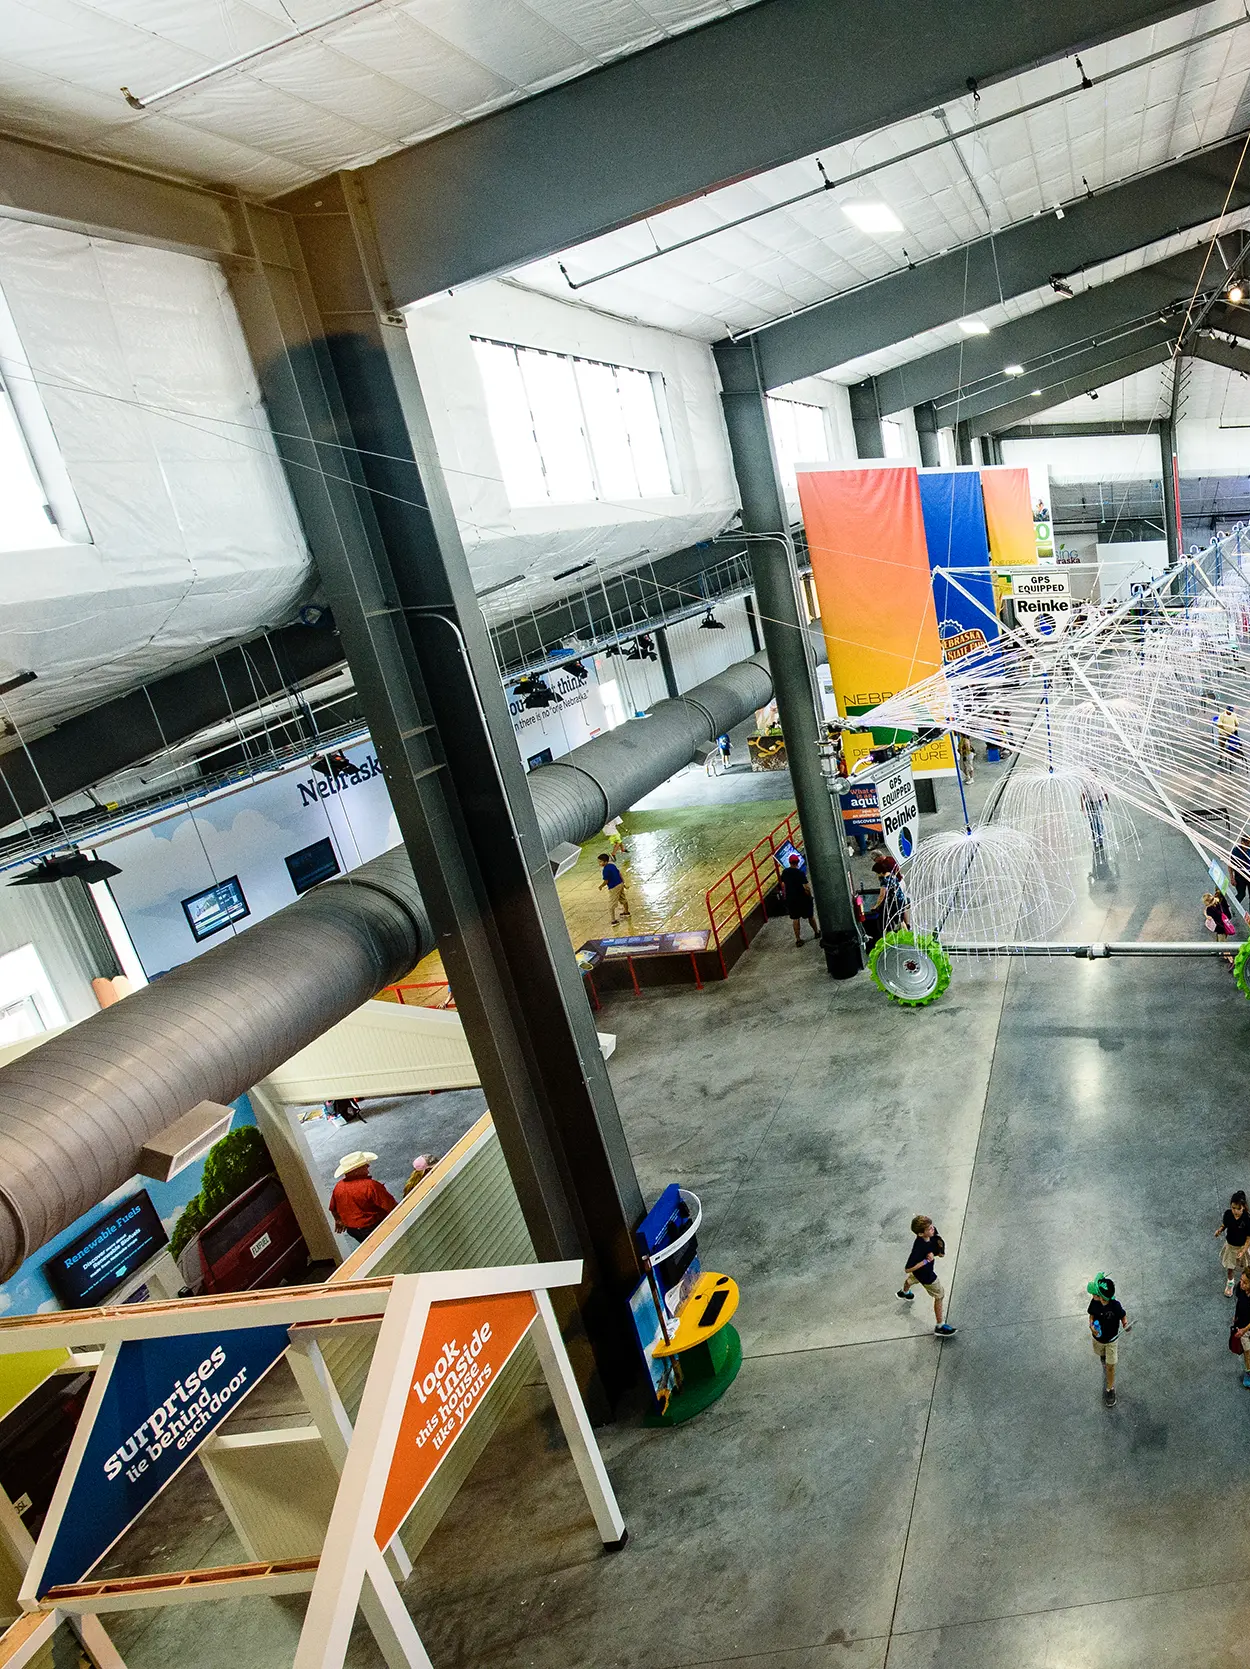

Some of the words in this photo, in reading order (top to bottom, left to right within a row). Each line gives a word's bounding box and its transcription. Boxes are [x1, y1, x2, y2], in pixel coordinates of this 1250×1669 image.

[1018, 584, 1065, 594] EQUIPPED
[1031, 576, 1050, 584] GPS
[1018, 600, 1069, 613] Reinke
[942, 631, 981, 649] EBRASKA
[948, 644, 968, 661] STATE
[296, 755, 384, 807] Nebrask
[882, 782, 912, 807] EQUIPPED
[889, 775, 902, 790] GPS
[884, 804, 916, 836] Reinke
[64, 1224, 118, 1269] Renewable
[116, 1205, 142, 1228] Fuels
[82, 1250, 106, 1270] Discover
[93, 1244, 121, 1269] Renewable
[413, 1339, 460, 1404] look
[436, 1321, 493, 1404] inside
[103, 1345, 227, 1482] surprises
[176, 1410, 212, 1451] each
[210, 1366, 248, 1414] door
[415, 1414, 439, 1449] this
[438, 1362, 480, 1423] house
[432, 1416, 456, 1450] like
[454, 1362, 492, 1424] yours
[126, 1459, 150, 1483] lie
[146, 1386, 212, 1462] behind
